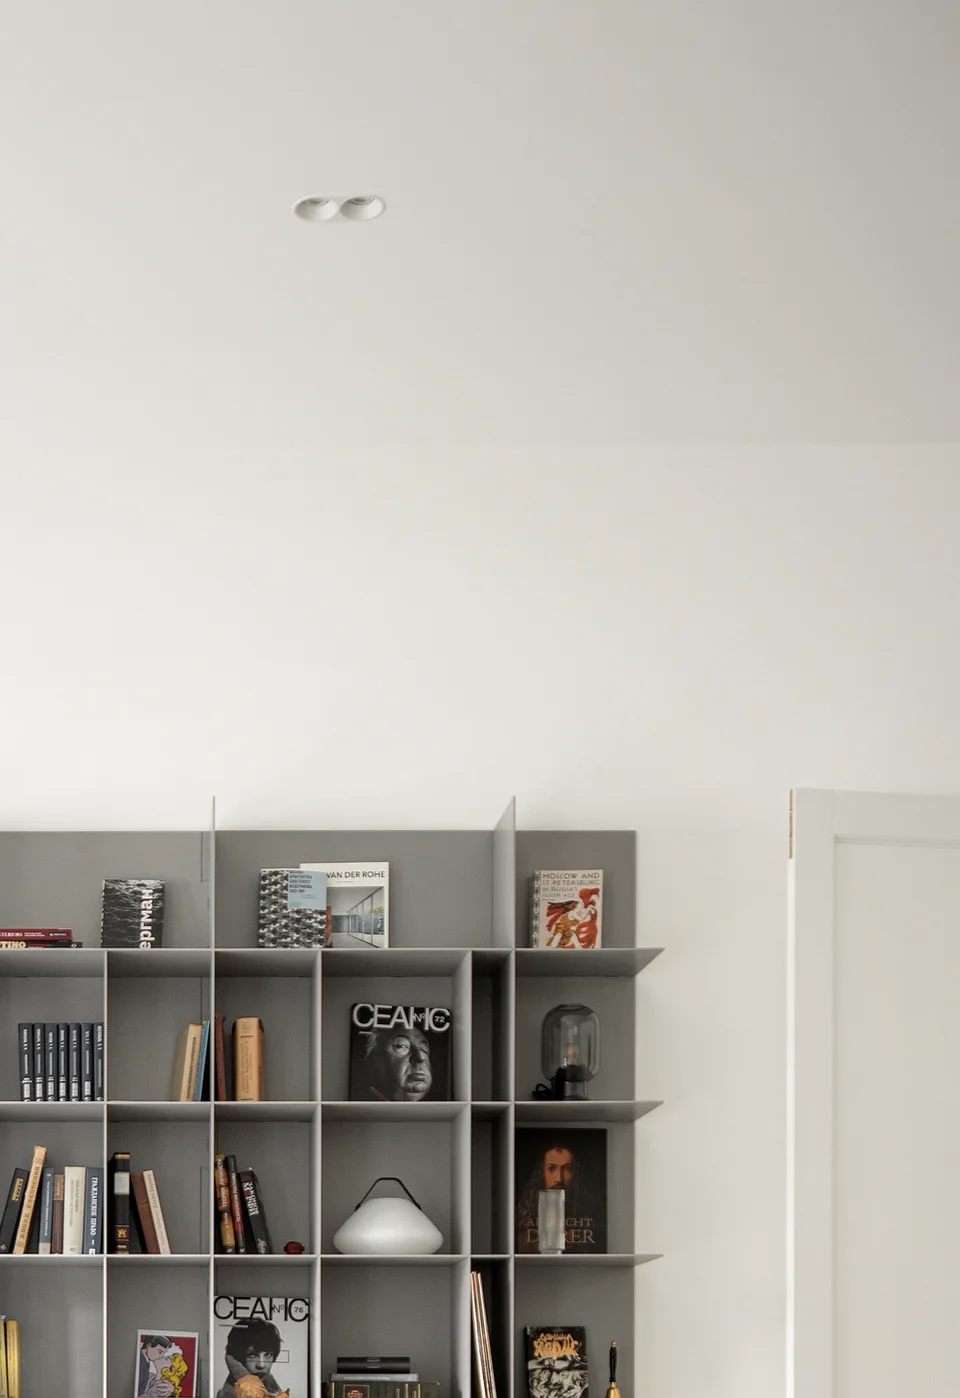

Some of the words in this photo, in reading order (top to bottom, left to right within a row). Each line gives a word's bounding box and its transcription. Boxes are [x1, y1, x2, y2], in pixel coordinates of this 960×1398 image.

[362, 870, 386, 878] ROHE
[434, 1015, 446, 1023] 72
[89, 1217, 98, 1236] ПРАВО
